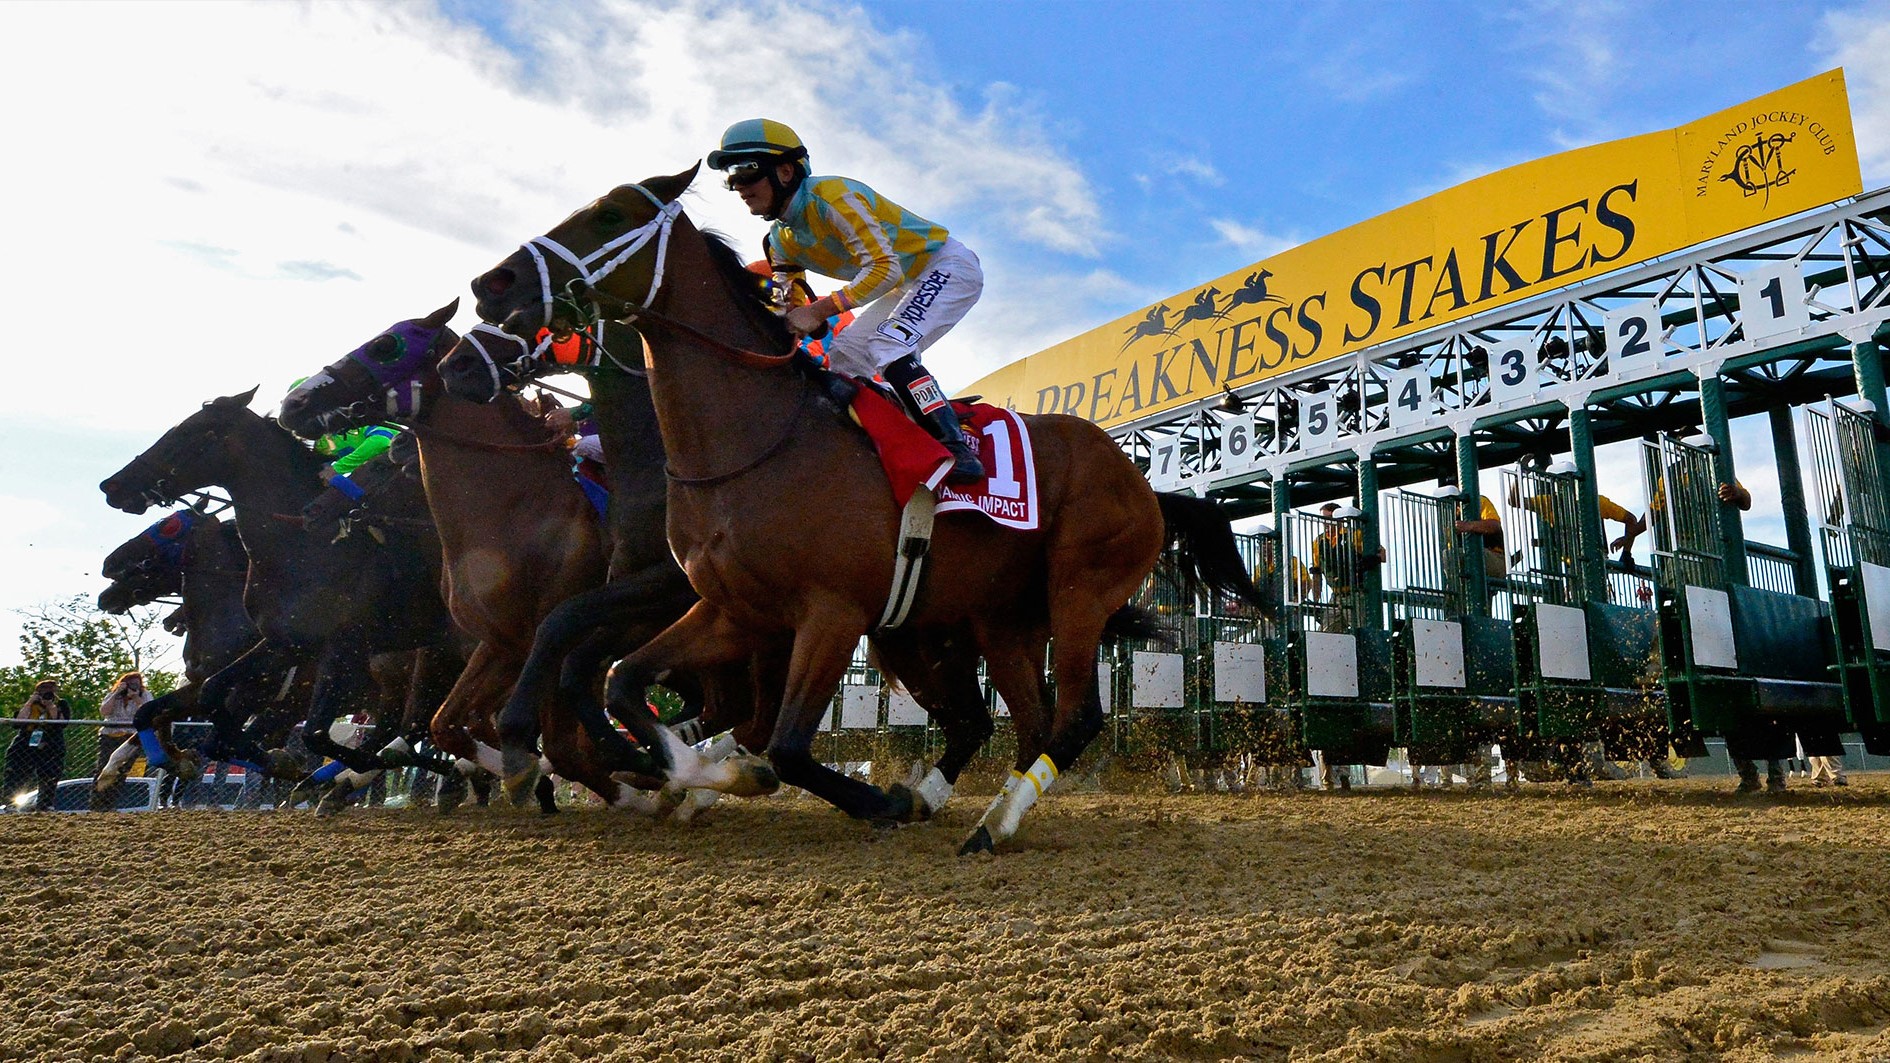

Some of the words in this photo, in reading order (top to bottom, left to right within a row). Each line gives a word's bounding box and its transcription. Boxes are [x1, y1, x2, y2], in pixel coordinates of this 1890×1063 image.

[1696, 122, 1748, 197] MARYLAND
[1750, 111, 1809, 130] JOCKEY
[1808, 122, 1836, 156] CLUB
[1036, 291, 1326, 424] PREAKNESS
[1343, 178, 1637, 347] STAKES
[1760, 277, 1785, 319] 1
[1619, 317, 1650, 358] 2
[1501, 349, 1527, 386] 3
[1398, 378, 1421, 411] 4
[1308, 402, 1329, 436] 5
[982, 419, 1020, 499] 1
[1229, 426, 1248, 456] 6
[1158, 445, 1174, 475] 7
[978, 496, 1026, 518] IMPACT
